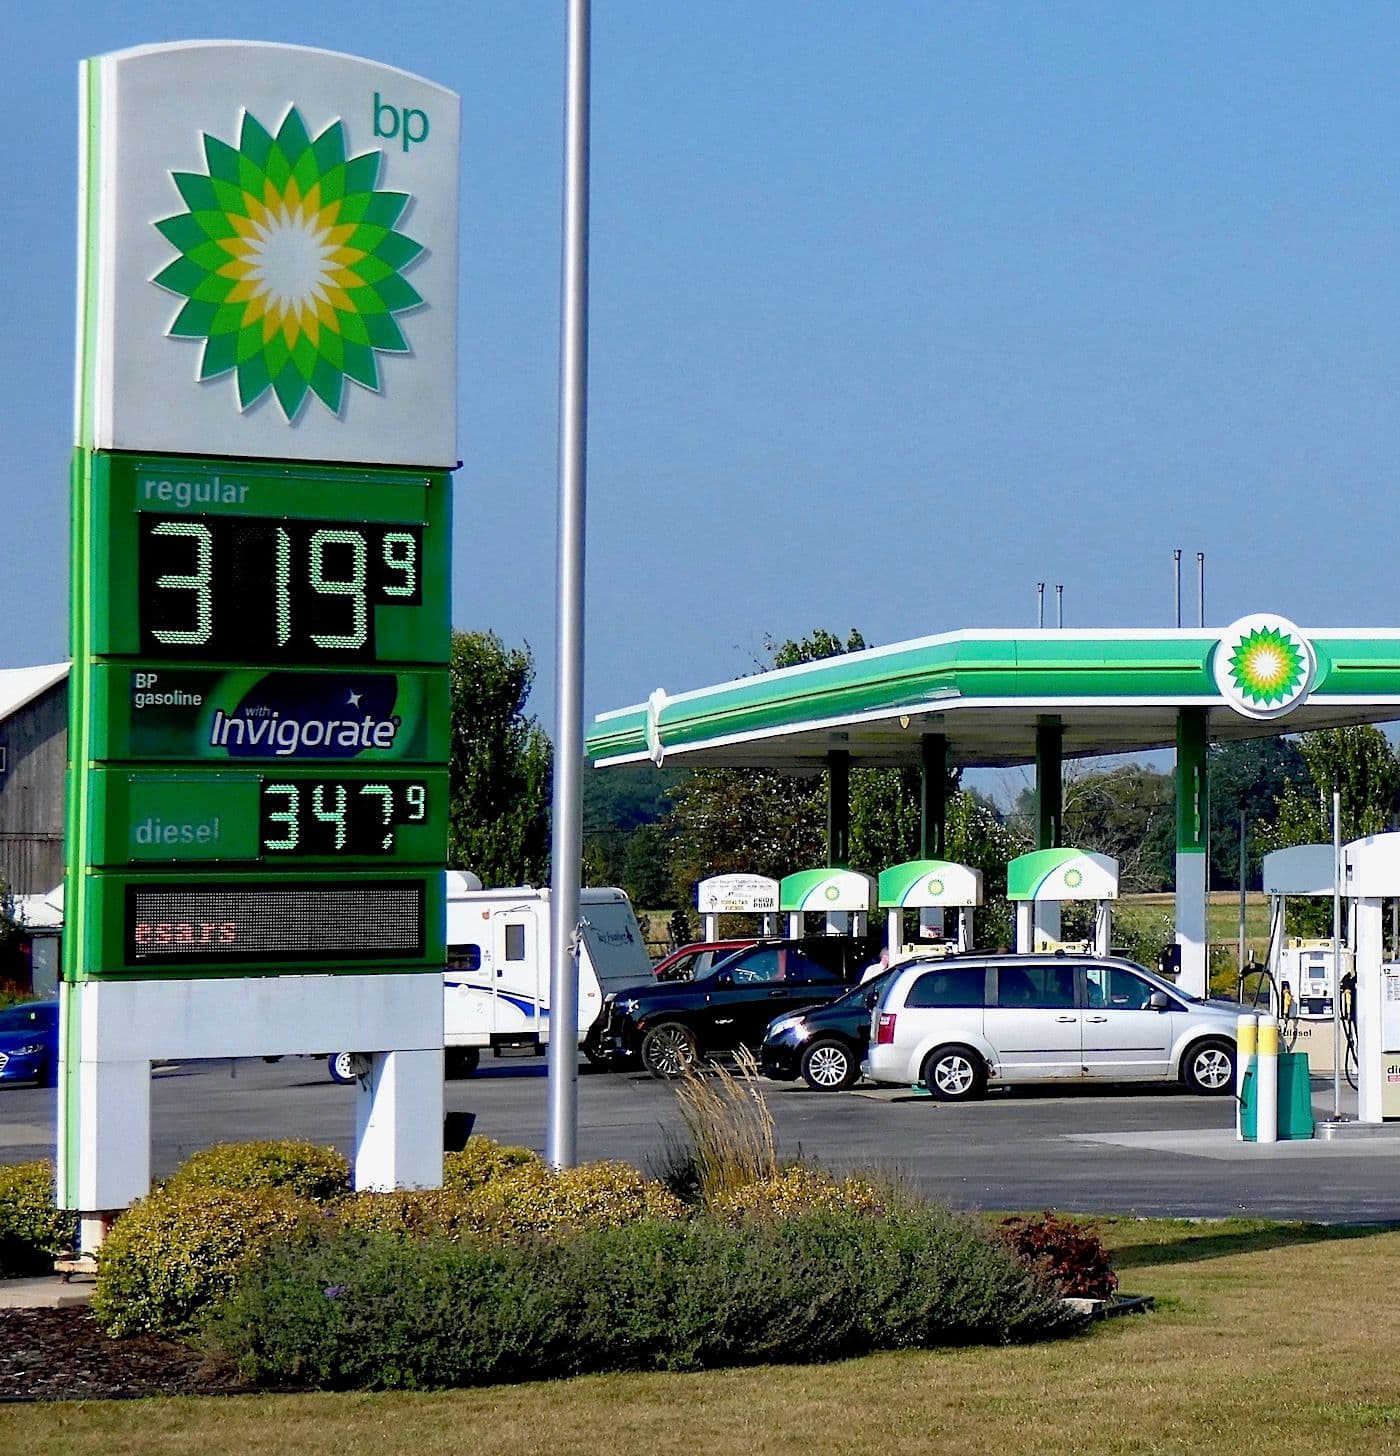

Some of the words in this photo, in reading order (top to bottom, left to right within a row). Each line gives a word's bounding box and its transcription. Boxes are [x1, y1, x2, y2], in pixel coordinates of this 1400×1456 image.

[374, 92, 429, 152] bp
[144, 477, 249, 508] regular
[135, 673, 158, 689] BP
[135, 690, 202, 708] gasoline
[245, 706, 271, 717] with
[136, 817, 219, 845] diesel
[1383, 968, 1391, 976] 12
